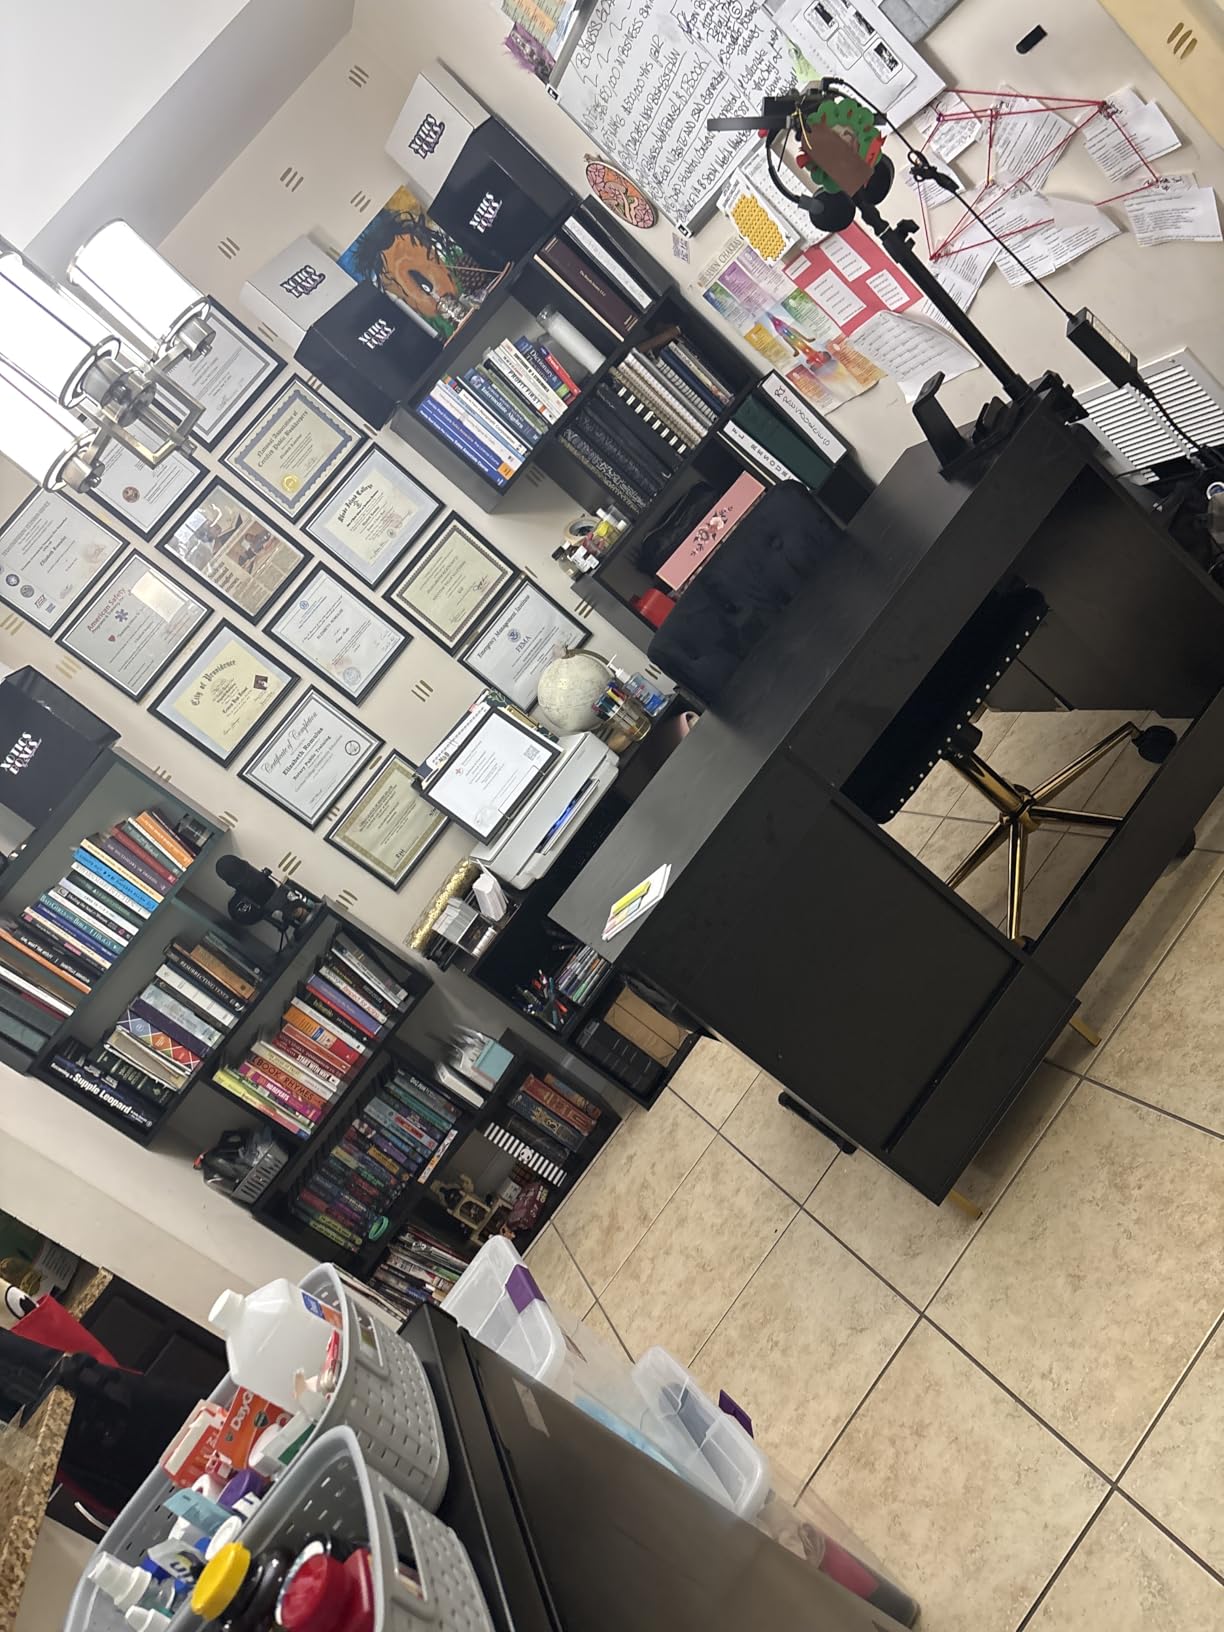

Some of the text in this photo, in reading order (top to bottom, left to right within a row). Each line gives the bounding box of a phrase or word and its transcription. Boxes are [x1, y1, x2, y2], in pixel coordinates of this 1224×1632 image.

[408, 114, 437, 152] XOTICS
[416, 123, 443, 158] BOXES
[468, 192, 495, 228] XOTICS
[475, 200, 500, 233] BOXES
[716, 236, 742, 263] CHAKRAS
[282, 264, 315, 293] XOTICS
[358, 317, 387, 345] XOTICS
[365, 324, 392, 350] BOXES
[527, 348, 554, 379] Dictionary
[507, 369, 527, 390] PROFIT
[524, 388, 541, 404] FIRST
[773, 385, 786, 398] RI
[480, 385, 509, 414] Intermediate
[505, 410, 525, 429] Algebra
[272, 434, 288, 451] Public
[86, 585, 126, 632] American Safety
[475, 635, 498, 659] Emergency
[493, 610, 519, 638] Management
[514, 633, 533, 653] FEMA
[287, 709, 321, 744] Completion
[0, 730, 32, 771] XOTICS
[8, 739, 38, 774] BOXES
[280, 725, 326, 776] Elizabeth Romulus
[303, 752, 318, 767] Public
[256, 1058, 281, 1079] BOOK
[282, 1076, 314, 1100] RHYMES
[296, 1053, 311, 1067] START
[309, 1062, 321, 1073] WITH
[318, 1068, 330, 1079] WHY
[71, 1072, 101, 1097] Supple
[97, 1089, 132, 1116] Leopard
[228, 1390, 256, 1431] DayQ
